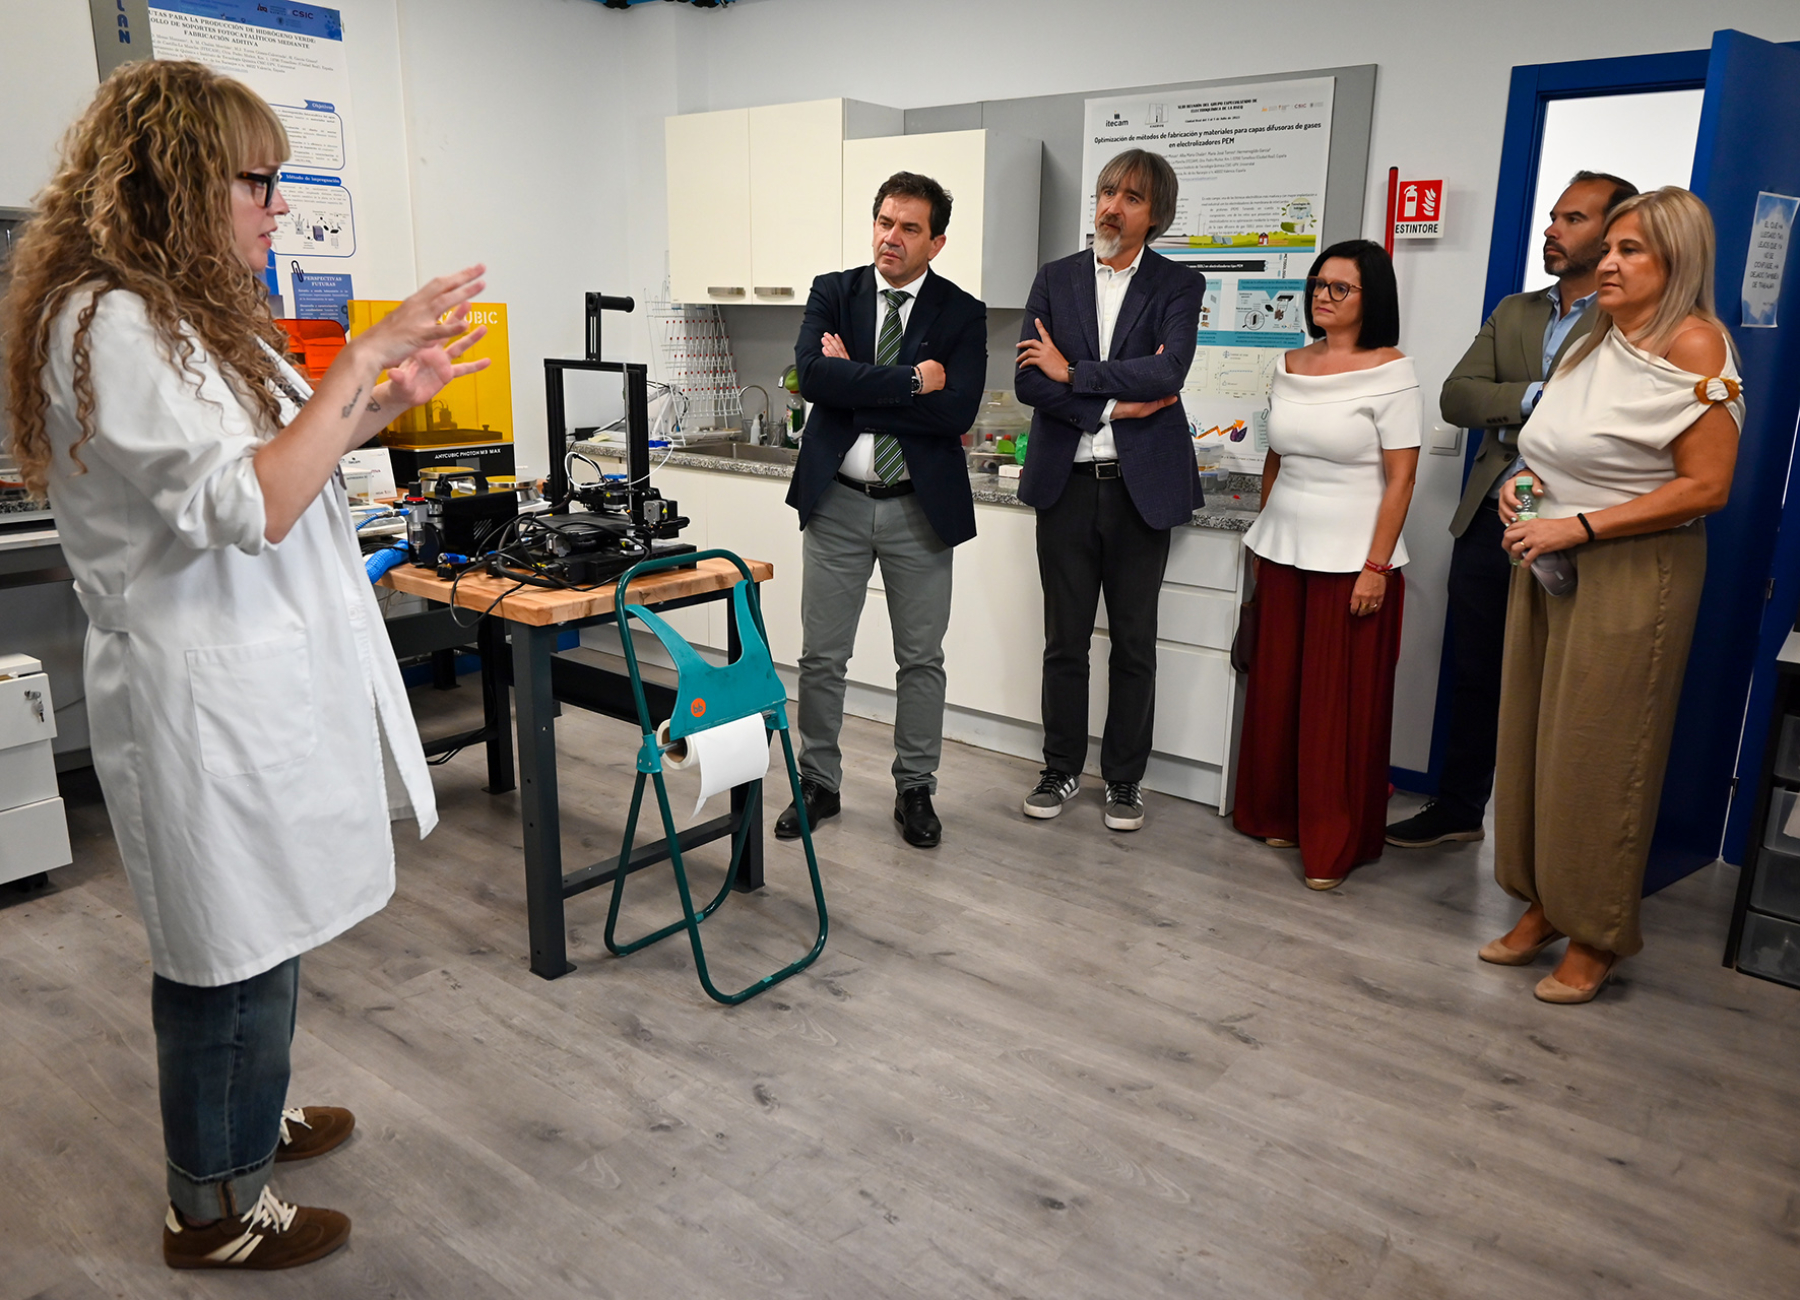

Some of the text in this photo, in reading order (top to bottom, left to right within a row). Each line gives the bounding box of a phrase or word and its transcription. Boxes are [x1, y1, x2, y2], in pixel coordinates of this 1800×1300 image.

[292, 9, 314, 19] CSIC
[148, 9, 167, 17] UTAS
[168, 13, 188, 21] PARA
[200, 19, 244, 31] PRODUCCIÓN
[255, 28, 293, 39] HIDRÓGENO
[150, 17, 169, 25] OLLO
[182, 22, 216, 33] SOPORTES
[277, 39, 310, 49] MEDIANTE
[184, 30, 230, 42] FABRICACIÓN
[232, 38, 259, 47] ADITIVA
[1106, 119, 1129, 127] itecam
[1094, 135, 1128, 145] Optimización
[1128, 134, 1135, 142] de
[1136, 132, 1159, 141] métodos
[1167, 130, 1198, 139] fabricación
[1203, 127, 1233, 136] materiales
[1234, 127, 1248, 135] para
[1248, 126, 1265, 134] capas
[1266, 123, 1294, 132] difusoras
[1295, 122, 1303, 130] de
[1303, 122, 1322, 131] gases
[1176, 138, 1221, 148] electrolizadores
[1395, 223, 1439, 234] ESTINTORE
